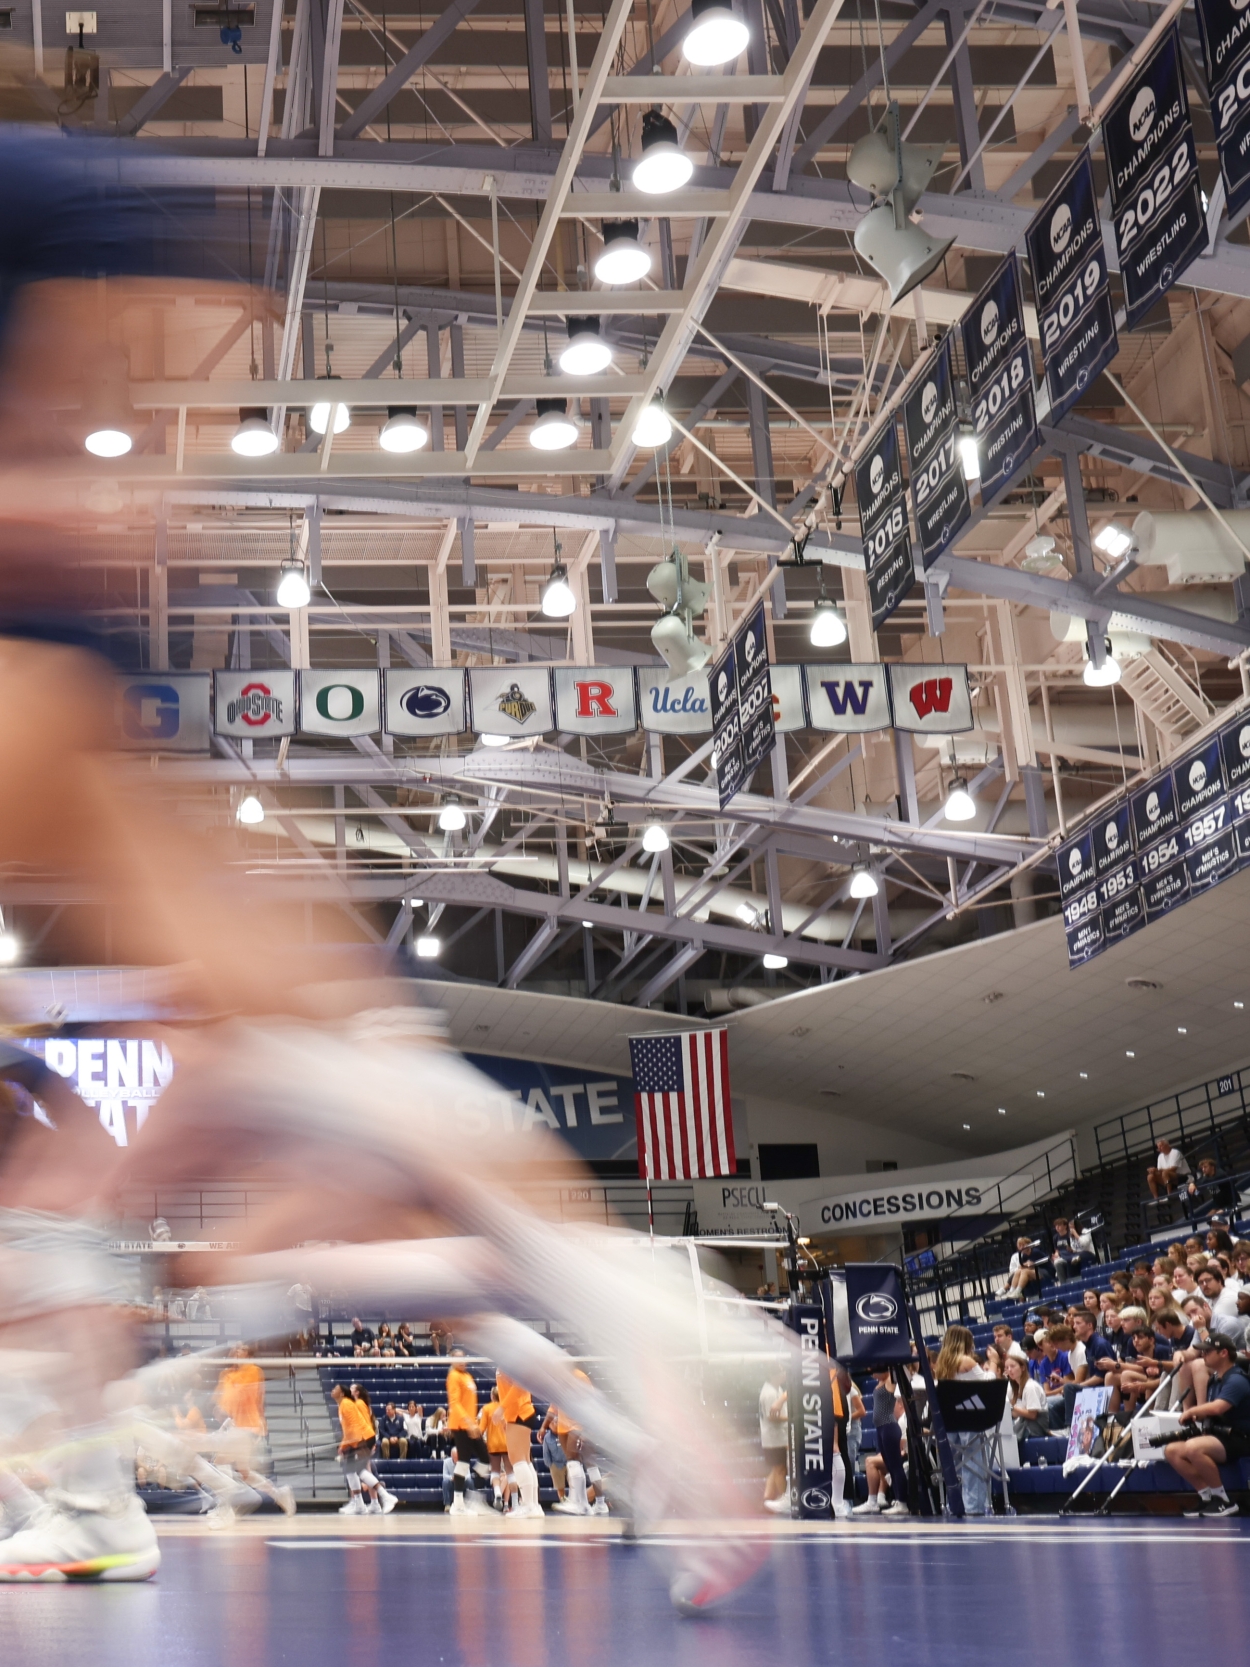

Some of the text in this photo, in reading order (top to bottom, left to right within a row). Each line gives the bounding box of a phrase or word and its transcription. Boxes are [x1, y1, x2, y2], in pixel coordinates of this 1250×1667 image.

[1132, 99, 1157, 136] NCAA
[1117, 100, 1181, 188] CHAMPIONS
[1119, 141, 1190, 251] 2022
[1053, 217, 1073, 246] NCAA
[1136, 212, 1187, 278] WRESTLING
[1039, 218, 1094, 295] CHAMPIONS
[983, 314, 999, 337] NCAA
[1043, 260, 1100, 350] 2019
[971, 318, 1018, 383] CHAMPIONS
[1058, 321, 1099, 378] WRESTLING
[975, 356, 1024, 433] 2018
[913, 400, 952, 458] CHAMPIONS
[987, 413, 1023, 459] WRESTLING
[916, 433, 956, 503] 2017
[927, 487, 958, 530] WRESTLING
[868, 506, 903, 568] 2016
[876, 556, 904, 591] RESTLING
[250, 692, 284, 725] STATE
[315, 683, 365, 722] O
[499, 701, 537, 721] PURDUE
[574, 680, 618, 719] R
[741, 676, 768, 725] 2007
[820, 680, 873, 716] W
[909, 677, 953, 721] W
[714, 714, 739, 757] 2004
[1184, 804, 1226, 847] 1957
[1141, 836, 1179, 873] 1954
[1100, 865, 1134, 900] 1953
[1065, 891, 1098, 924] 1948
[45, 1038, 174, 1088] PENN
[75, 1087, 161, 1099] LLEYBALL
[1219, 1079, 1232, 1093] 201
[451, 1080, 625, 1136] STATE
[722, 1186, 766, 1208] PSECU
[821, 1186, 983, 1224] CONCESSIONS
[699, 1227, 735, 1237] OMEN'S
[858, 1325, 899, 1335] PENN STATE
[800, 1317, 825, 1472] PENN STATE
